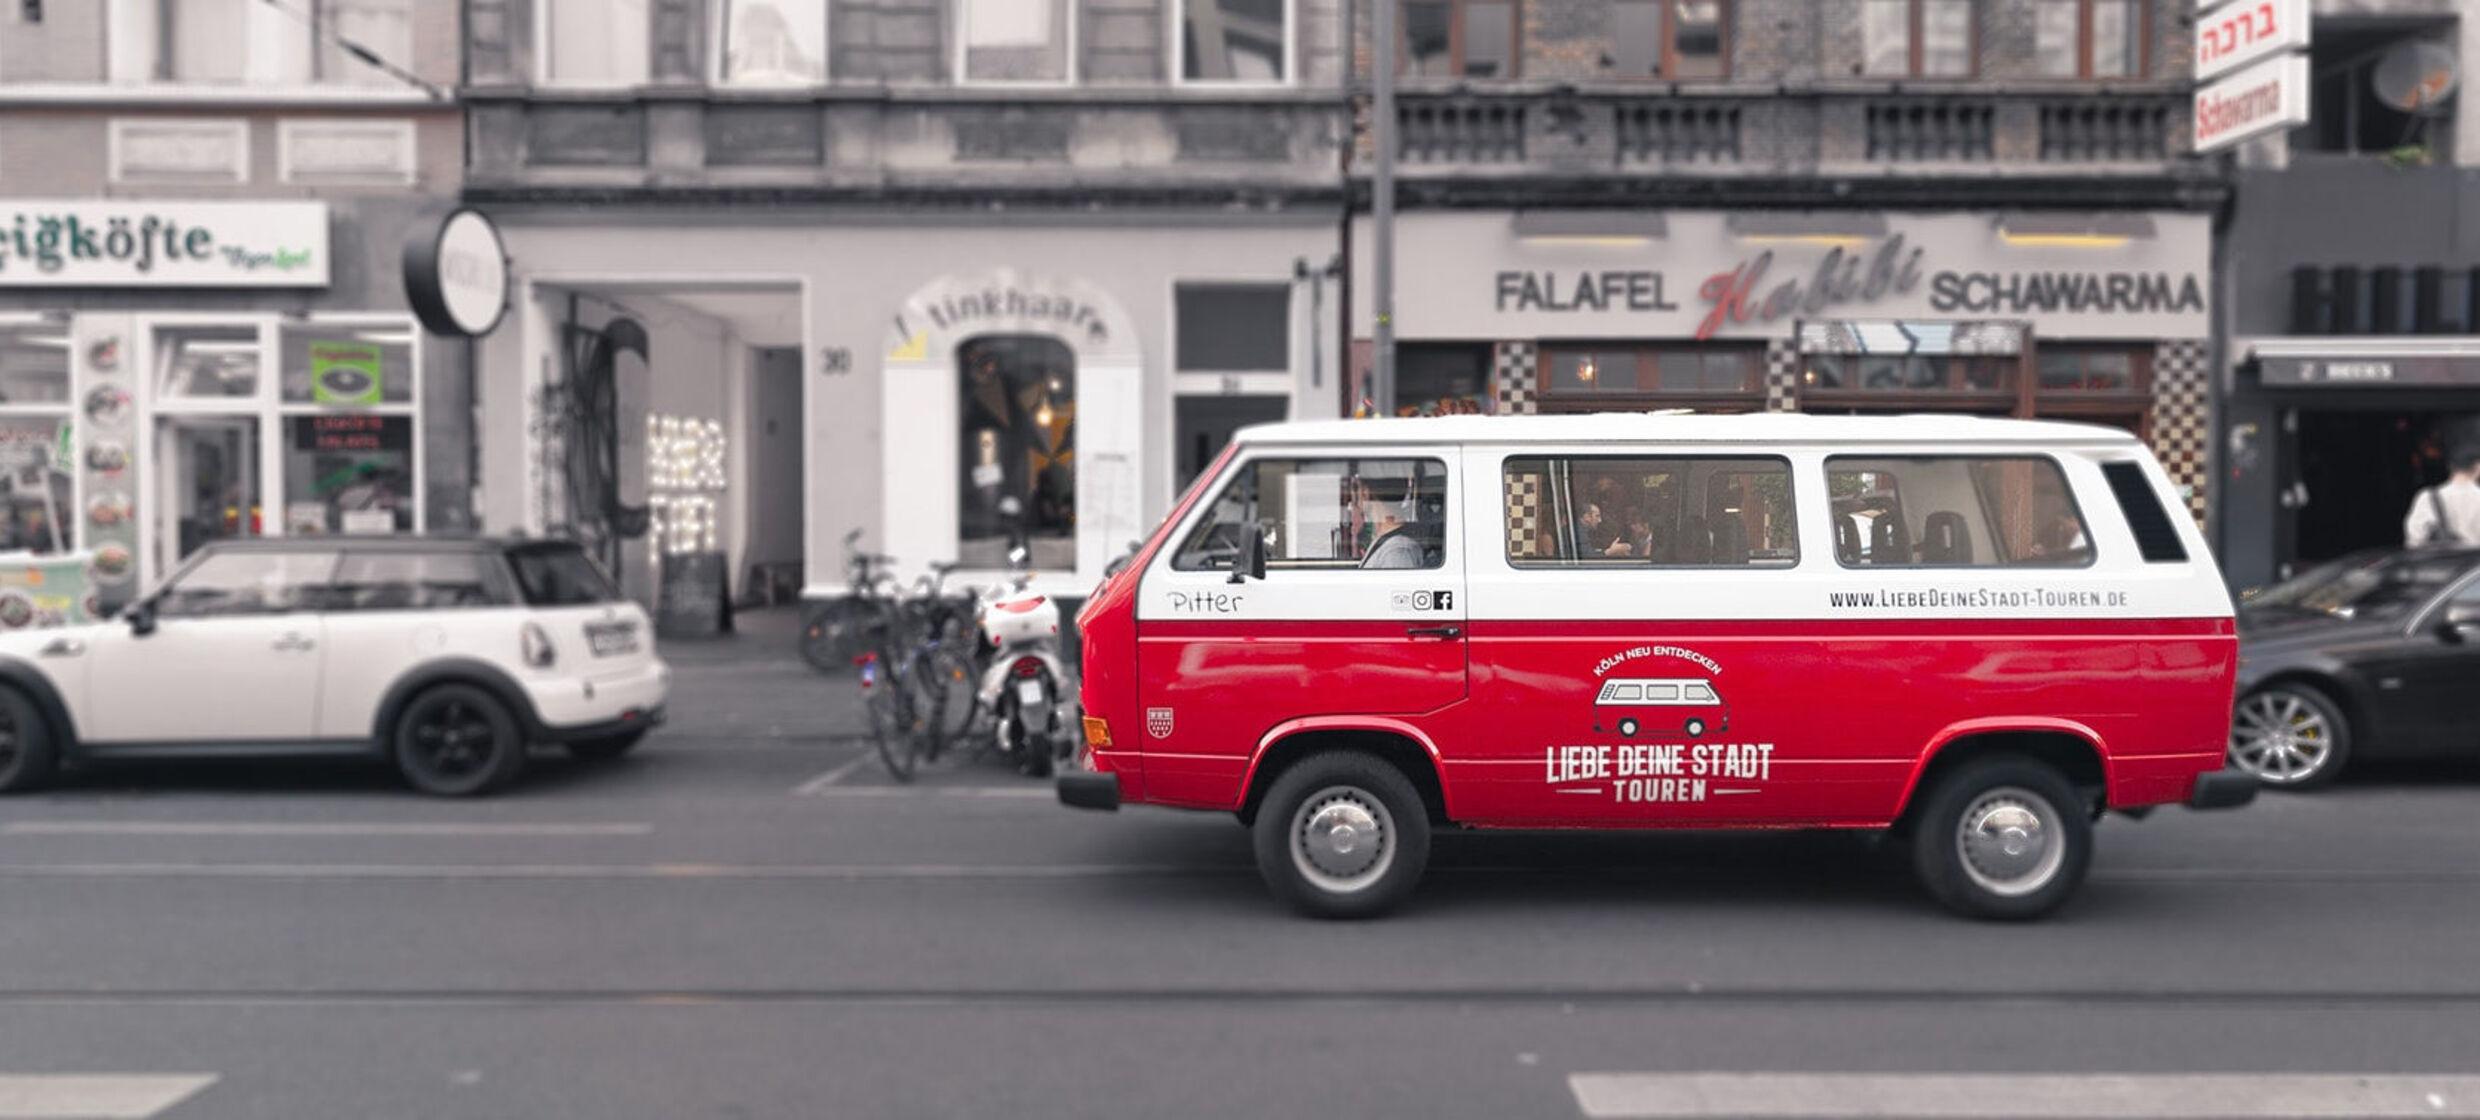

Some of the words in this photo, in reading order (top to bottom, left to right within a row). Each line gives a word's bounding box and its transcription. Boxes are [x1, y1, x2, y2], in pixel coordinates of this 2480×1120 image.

[2201, 4, 2277, 62] ברכה
[1496, 271, 1677, 312] FALAFEL
[1695, 233, 1923, 340] Habibi
[1930, 271, 2204, 313] SCHAWARMA
[1166, 591, 1244, 613] Pitter
[1593, 652, 1625, 677] KÖLN
[1626, 646, 1651, 660] NEU
[1653, 646, 1722, 676] ENTDECKEN
[1546, 745, 1612, 784] LIEBE
[1618, 744, 1686, 777] DEINE
[1691, 743, 1774, 781] STADT
[1613, 778, 1707, 803] TOUREN
